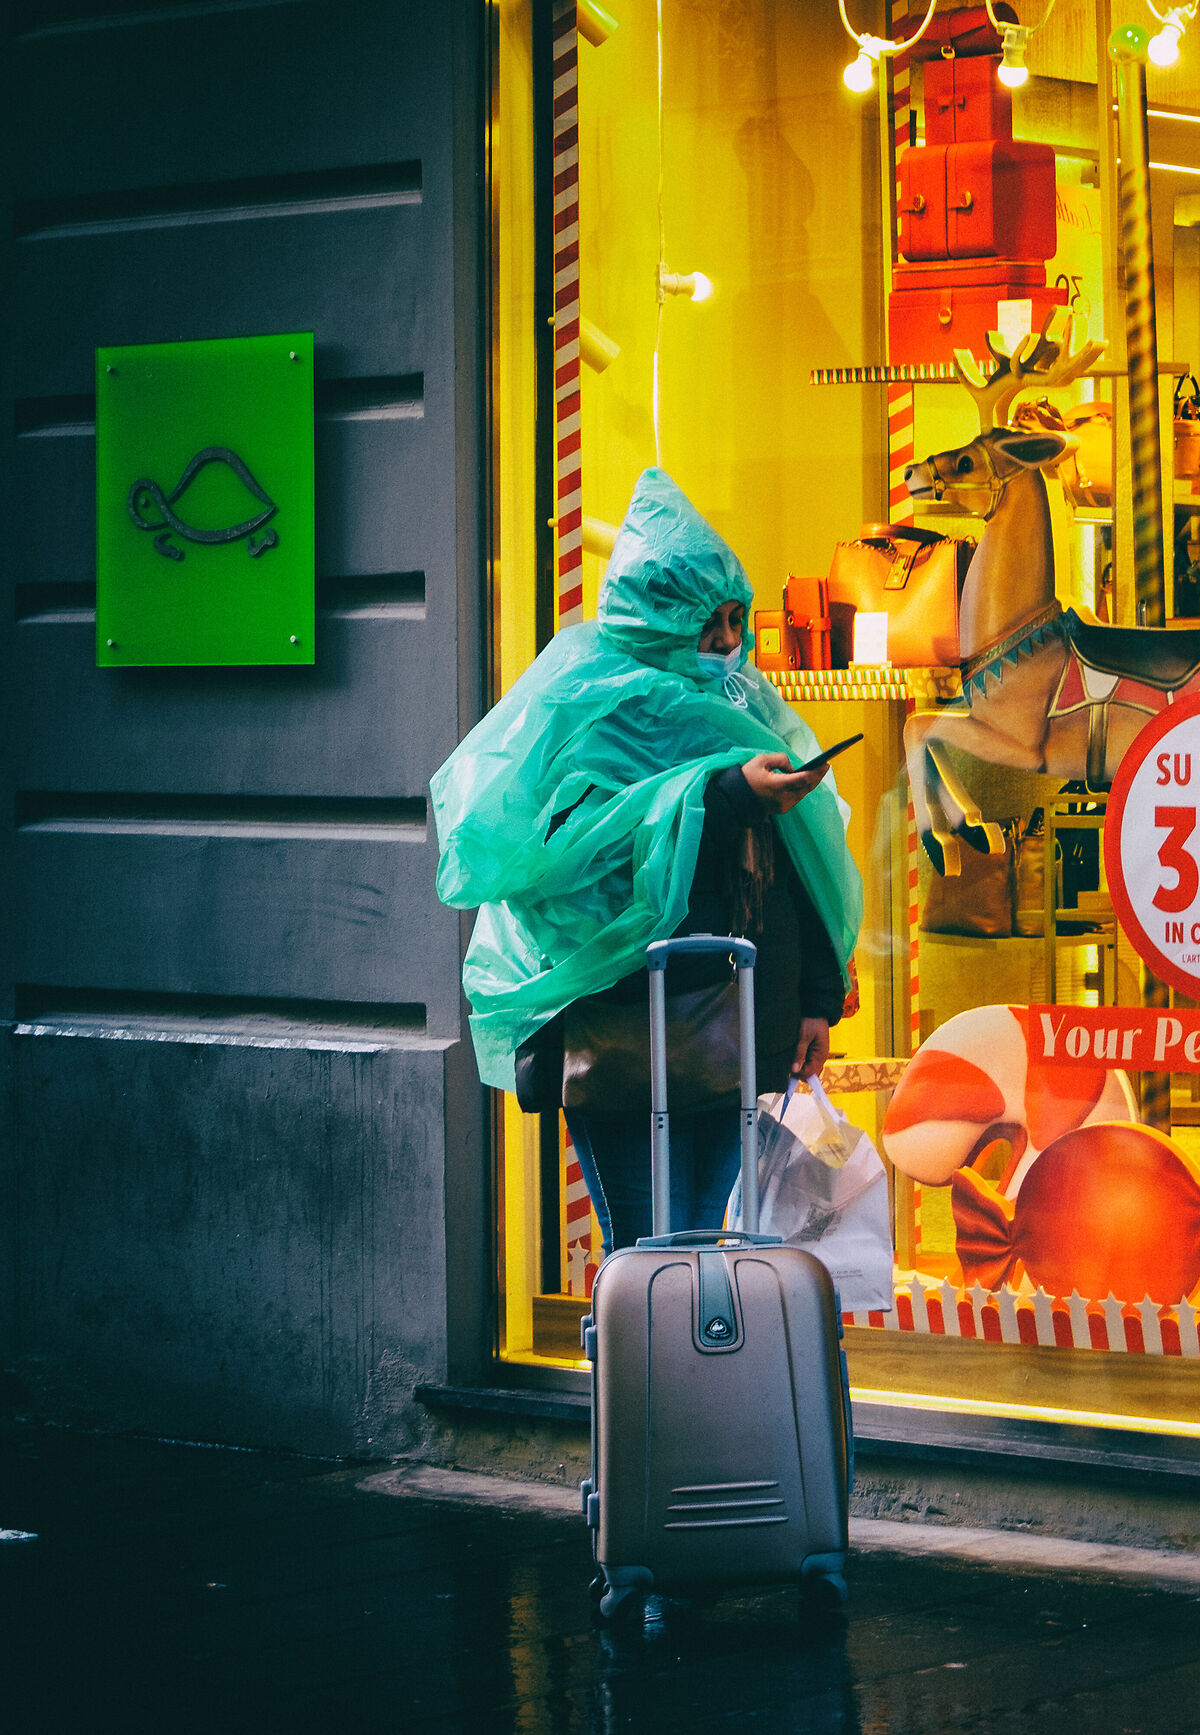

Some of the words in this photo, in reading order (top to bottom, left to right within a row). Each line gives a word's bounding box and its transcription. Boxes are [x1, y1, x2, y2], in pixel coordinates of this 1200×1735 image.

[1156, 753, 1192, 787] SU
[1165, 921, 1184, 944] IN
[1039, 1012, 1142, 1061] Your
